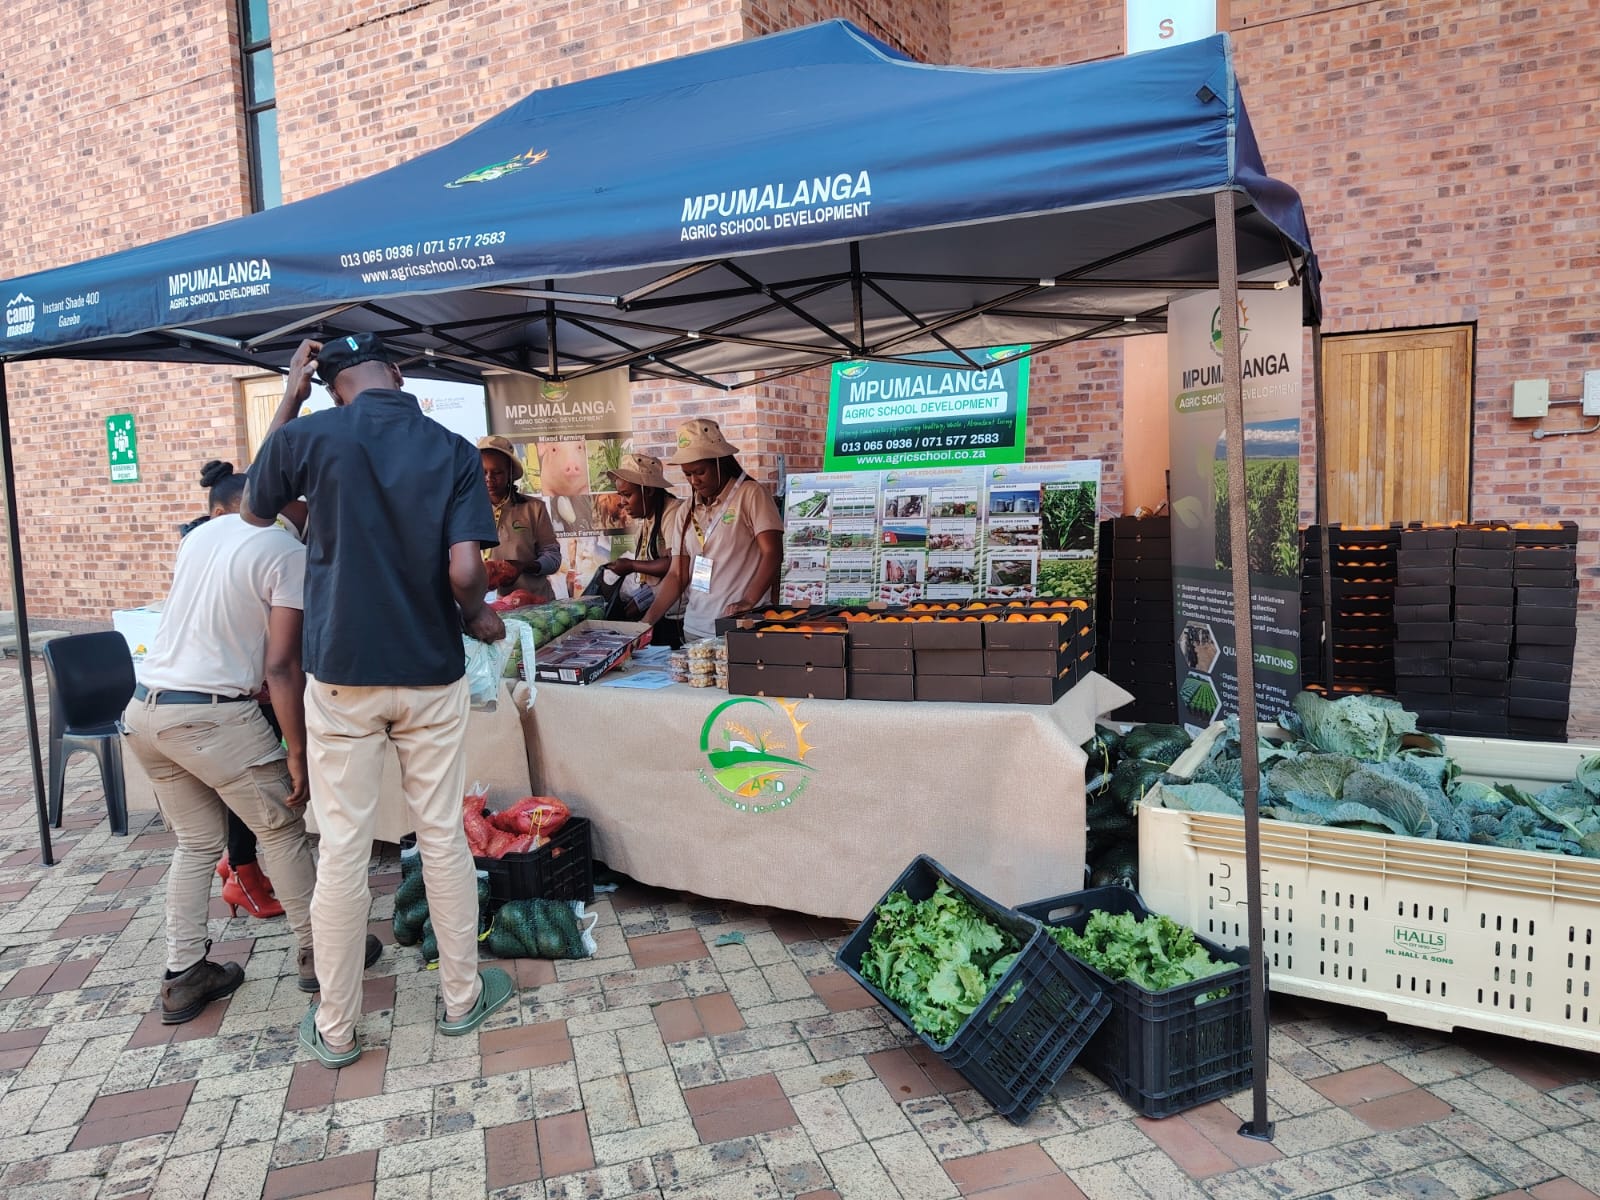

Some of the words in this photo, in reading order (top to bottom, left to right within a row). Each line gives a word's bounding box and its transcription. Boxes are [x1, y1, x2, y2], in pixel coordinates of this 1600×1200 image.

[1158, 18, 1174, 39] S
[681, 170, 871, 222] MPUMALANGA
[680, 224, 717, 242] AGRIC
[720, 216, 771, 236] SCHOOL
[774, 202, 871, 229] DEVELOPMENT
[340, 253, 360, 268] 013
[363, 249, 382, 264] 065
[386, 244, 413, 261] 0936
[424, 240, 445, 255] 071
[448, 236, 471, 250] 577
[474, 230, 506, 248] 2583
[168, 258, 271, 296] MPUMALANGA
[362, 254, 495, 284] www.agricschool.co.za
[42, 301, 64, 314] Instant
[65, 295, 84, 309] Shade
[86, 291, 100, 305] 400
[170, 296, 188, 310] AGRIC
[190, 292, 218, 306] SCHOOL
[220, 284, 270, 301] DEVELOPMENT
[6, 304, 34, 324] camp
[58, 313, 80, 328] Gazebo
[6, 320, 34, 338] master
[1182, 353, 1290, 390] MPUMANGA
[850, 368, 1004, 402] MPUMALANGA
[1179, 396, 1200, 408] AGRIC
[1242, 383, 1299, 400] EVELOPMENT
[505, 400, 616, 419] MPUMALANGA
[845, 406, 874, 420] AGRIC
[877, 402, 918, 416] SCHOOL
[920, 397, 1000, 413] DEVELOPMENT
[842, 442, 861, 452] 013
[864, 440, 882, 451] 065
[886, 438, 912, 449] 0936
[922, 436, 942, 447] 071
[946, 434, 966, 446] 577
[970, 433, 1000, 444] 2583
[856, 450, 986, 465] www.agricschool.co.za
[1396, 928, 1444, 946] HALLS
[1398, 950, 1419, 959] HALL
[1431, 956, 1454, 964] SONS
